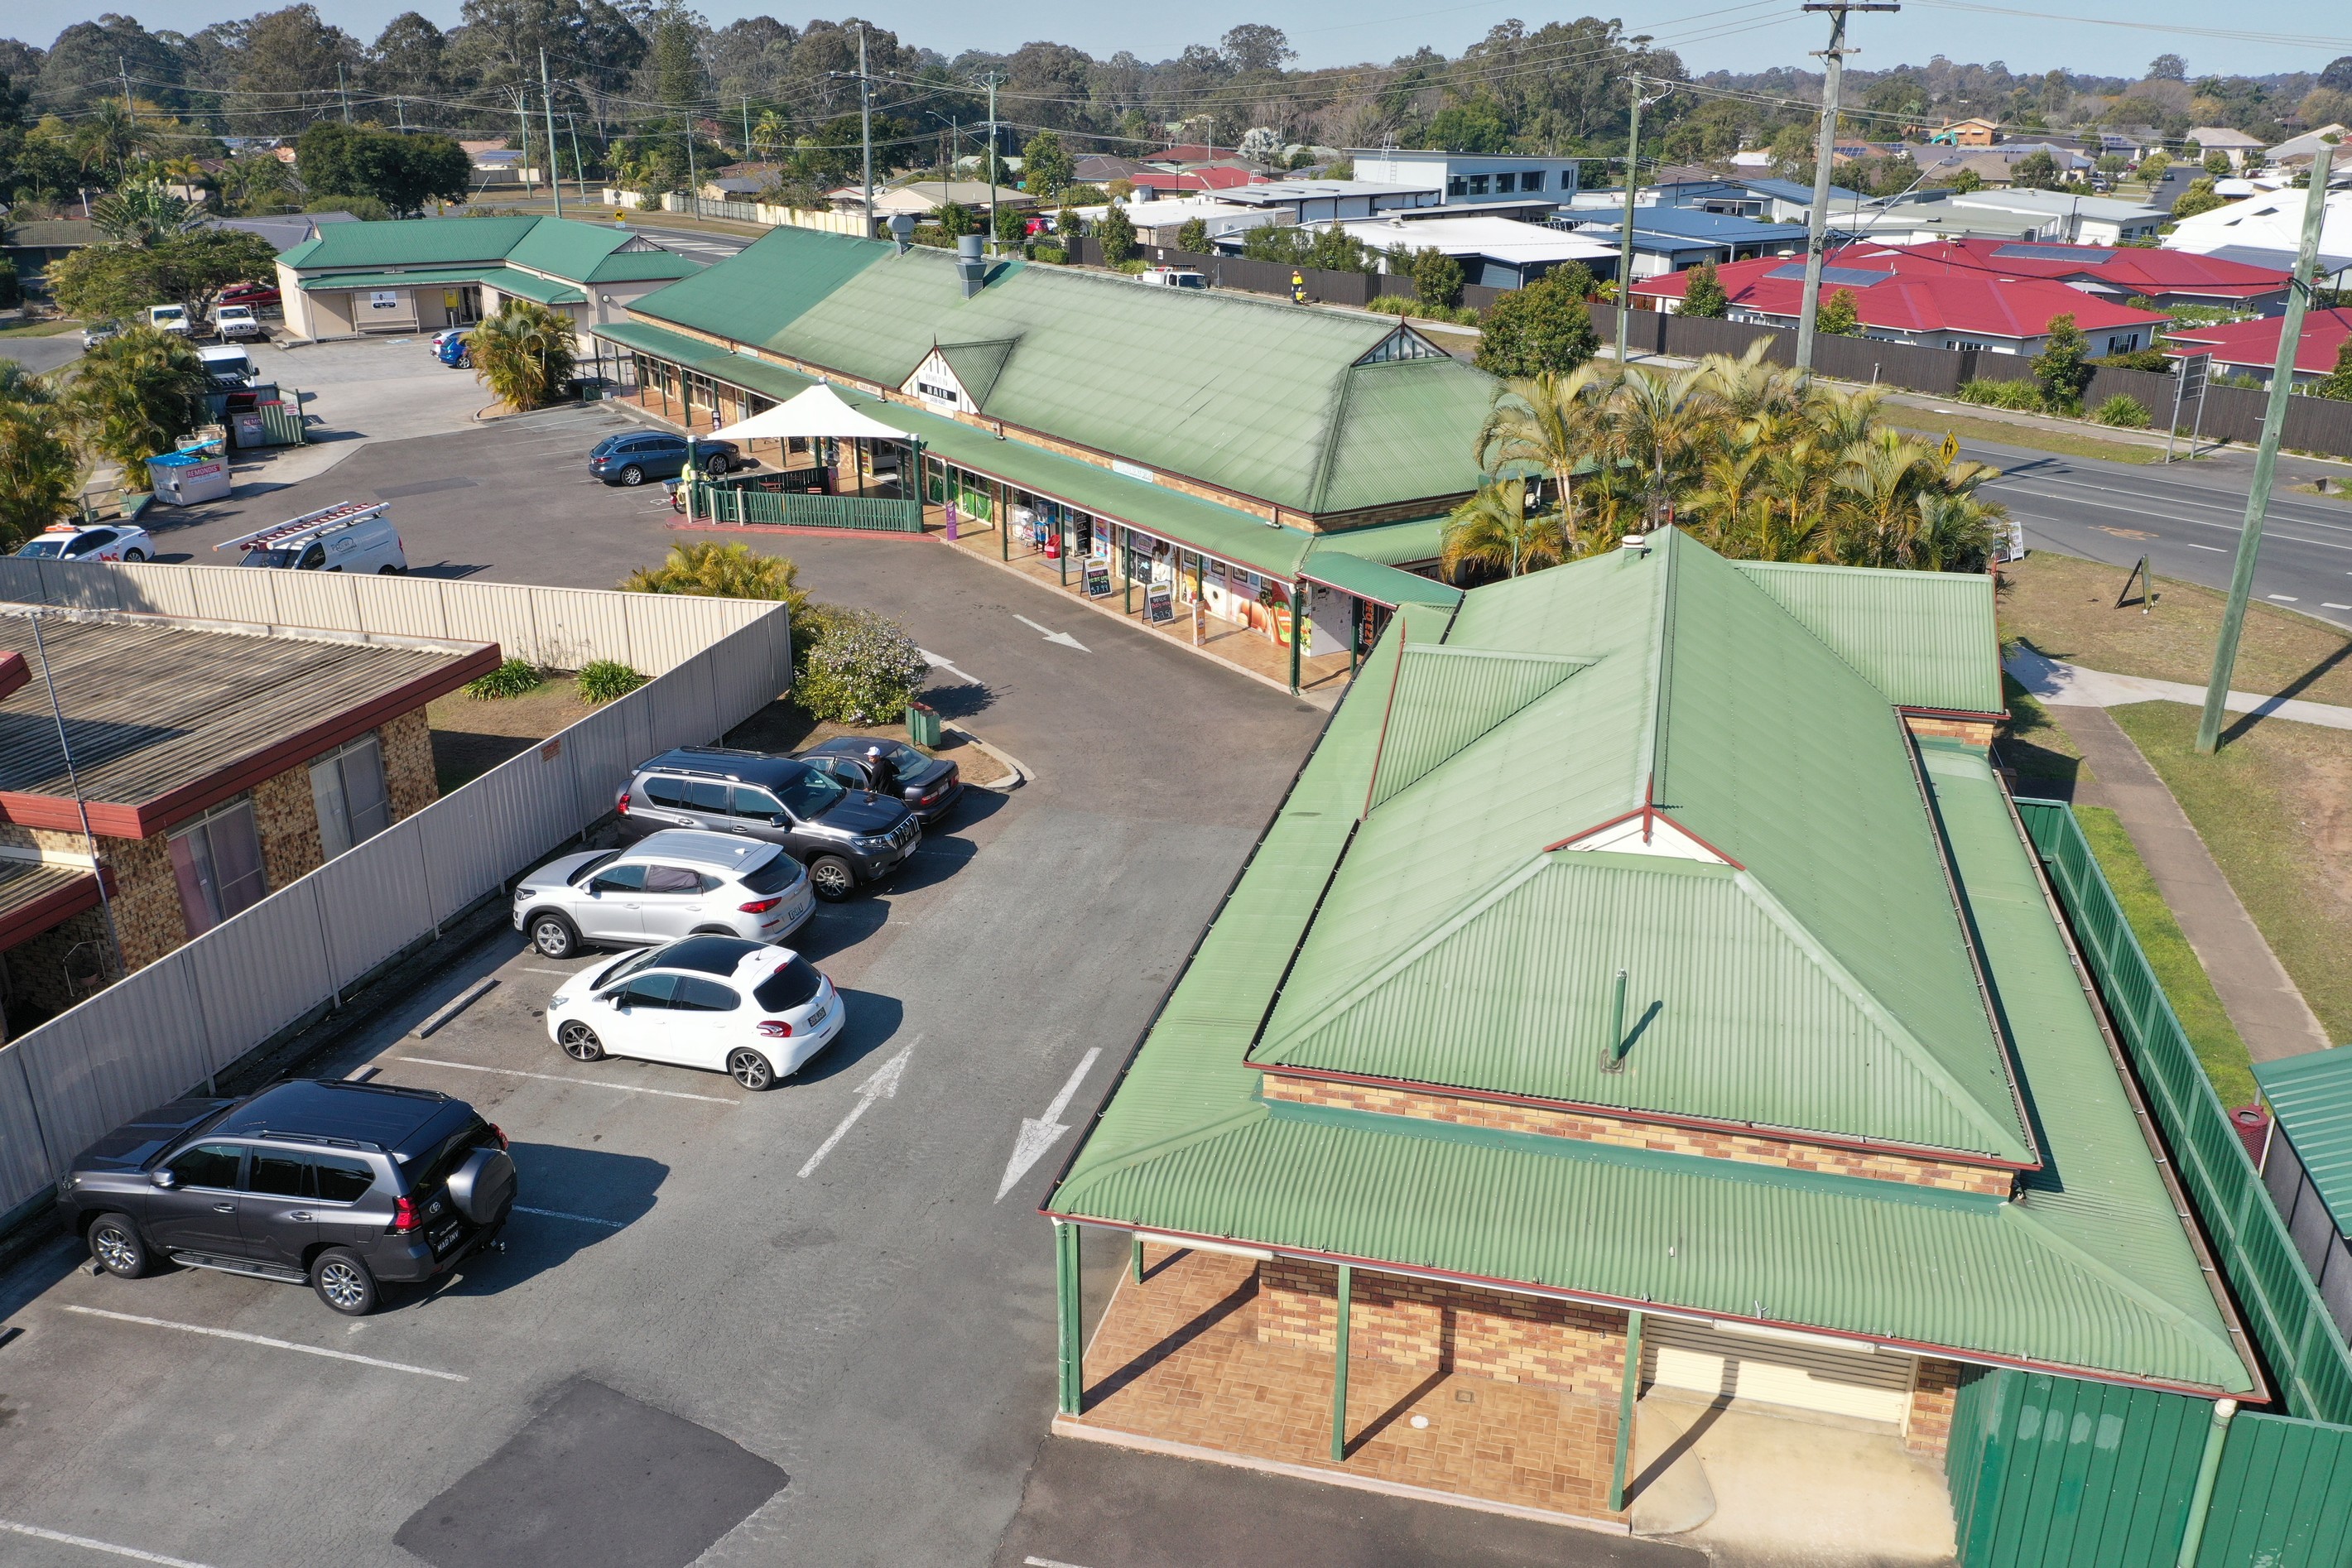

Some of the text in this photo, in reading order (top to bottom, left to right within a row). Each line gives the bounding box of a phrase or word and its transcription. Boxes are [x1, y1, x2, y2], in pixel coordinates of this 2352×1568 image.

[926, 385, 948, 399] HAIR
[187, 464, 218, 478] REMONDIS
[1365, 600, 1373, 622] DEO
[438, 1239, 449, 1252] MAD
[449, 1229, 459, 1243] INV
